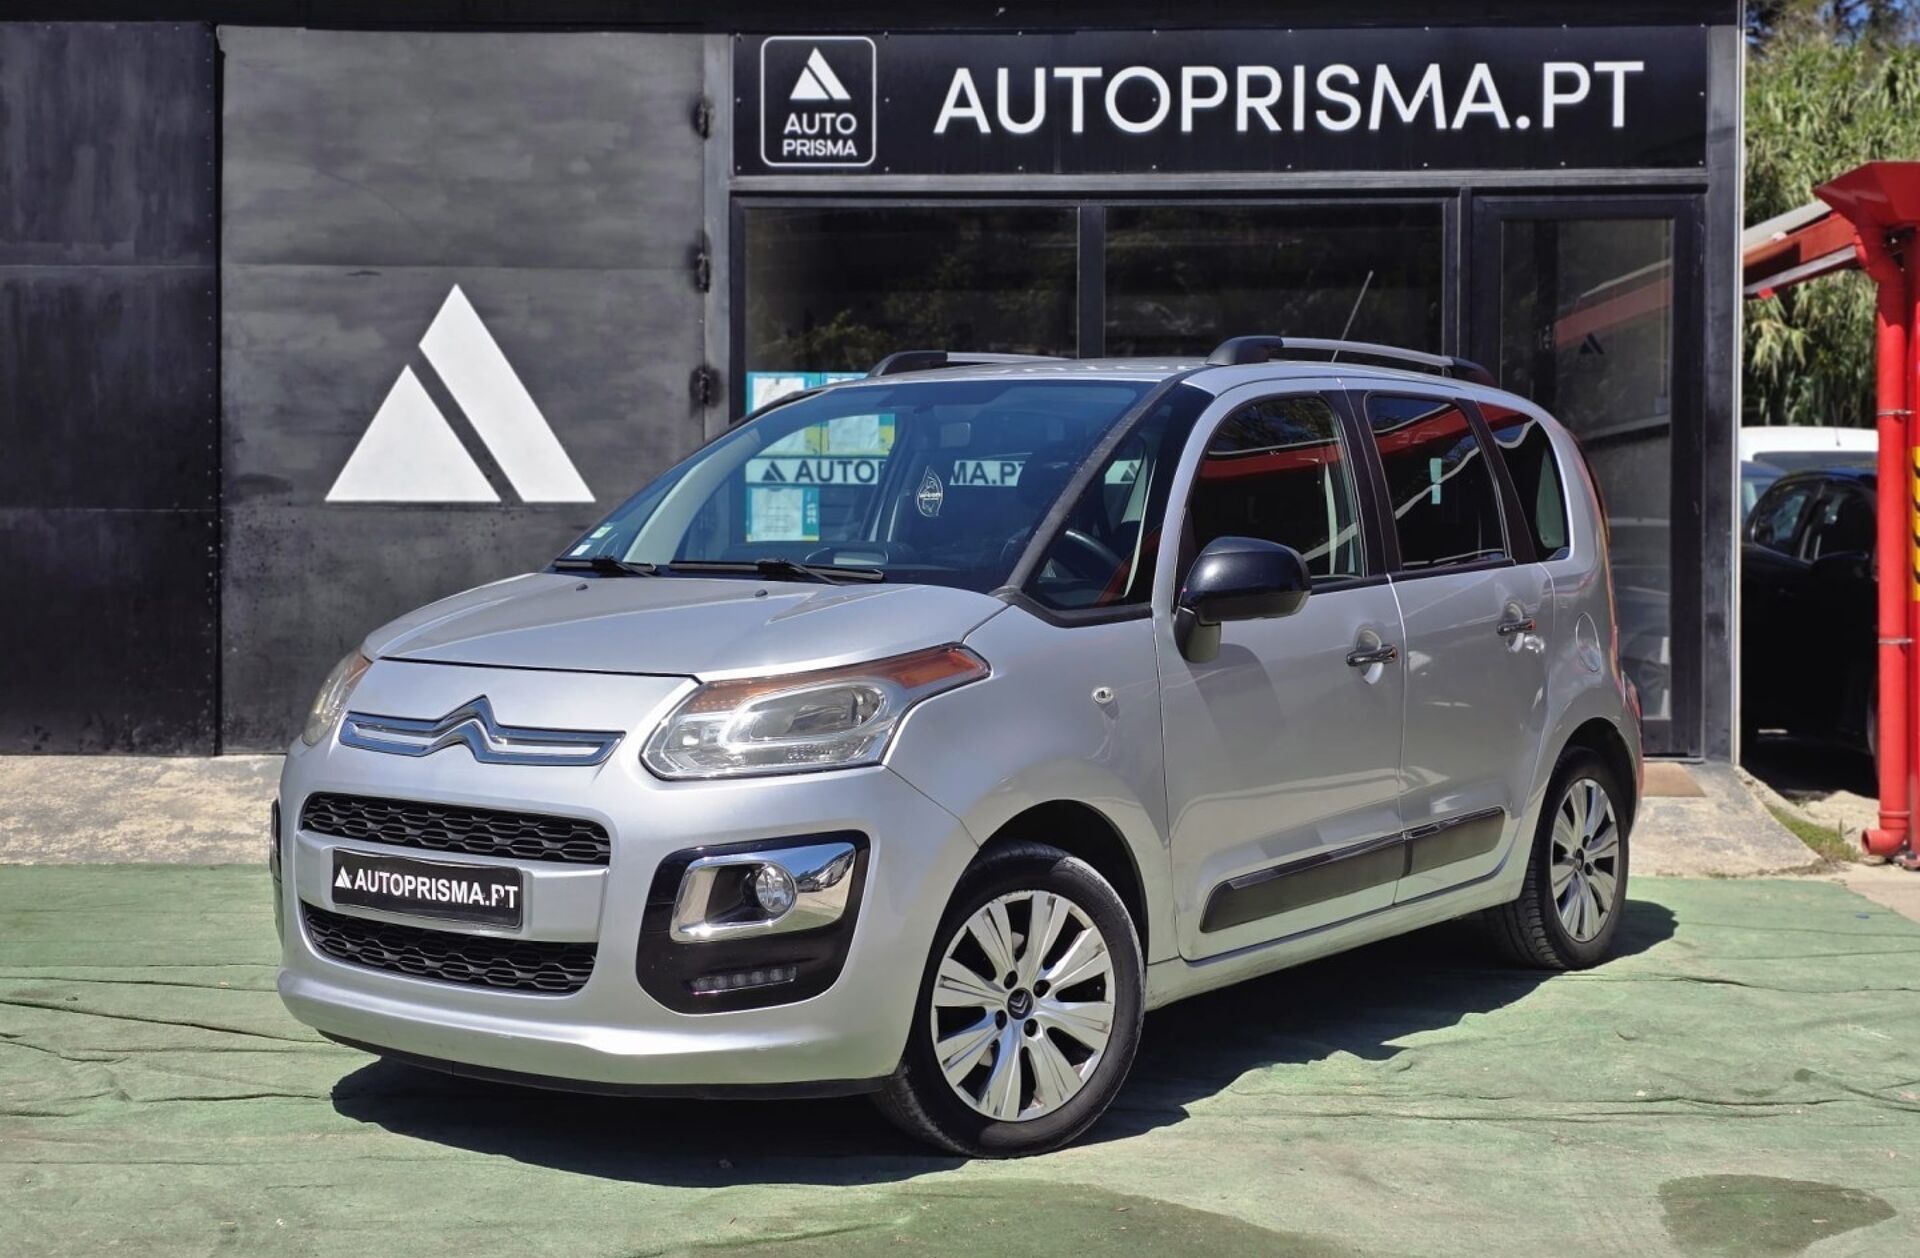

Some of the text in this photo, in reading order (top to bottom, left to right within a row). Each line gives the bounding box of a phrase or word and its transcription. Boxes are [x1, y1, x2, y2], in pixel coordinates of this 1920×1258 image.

[934, 61, 1645, 135] AUTOPRISMA.PT
[783, 113, 857, 135] AUTO
[783, 139, 857, 157] PRISMA
[354, 868, 518, 908] AUTOPRISMA.PT
